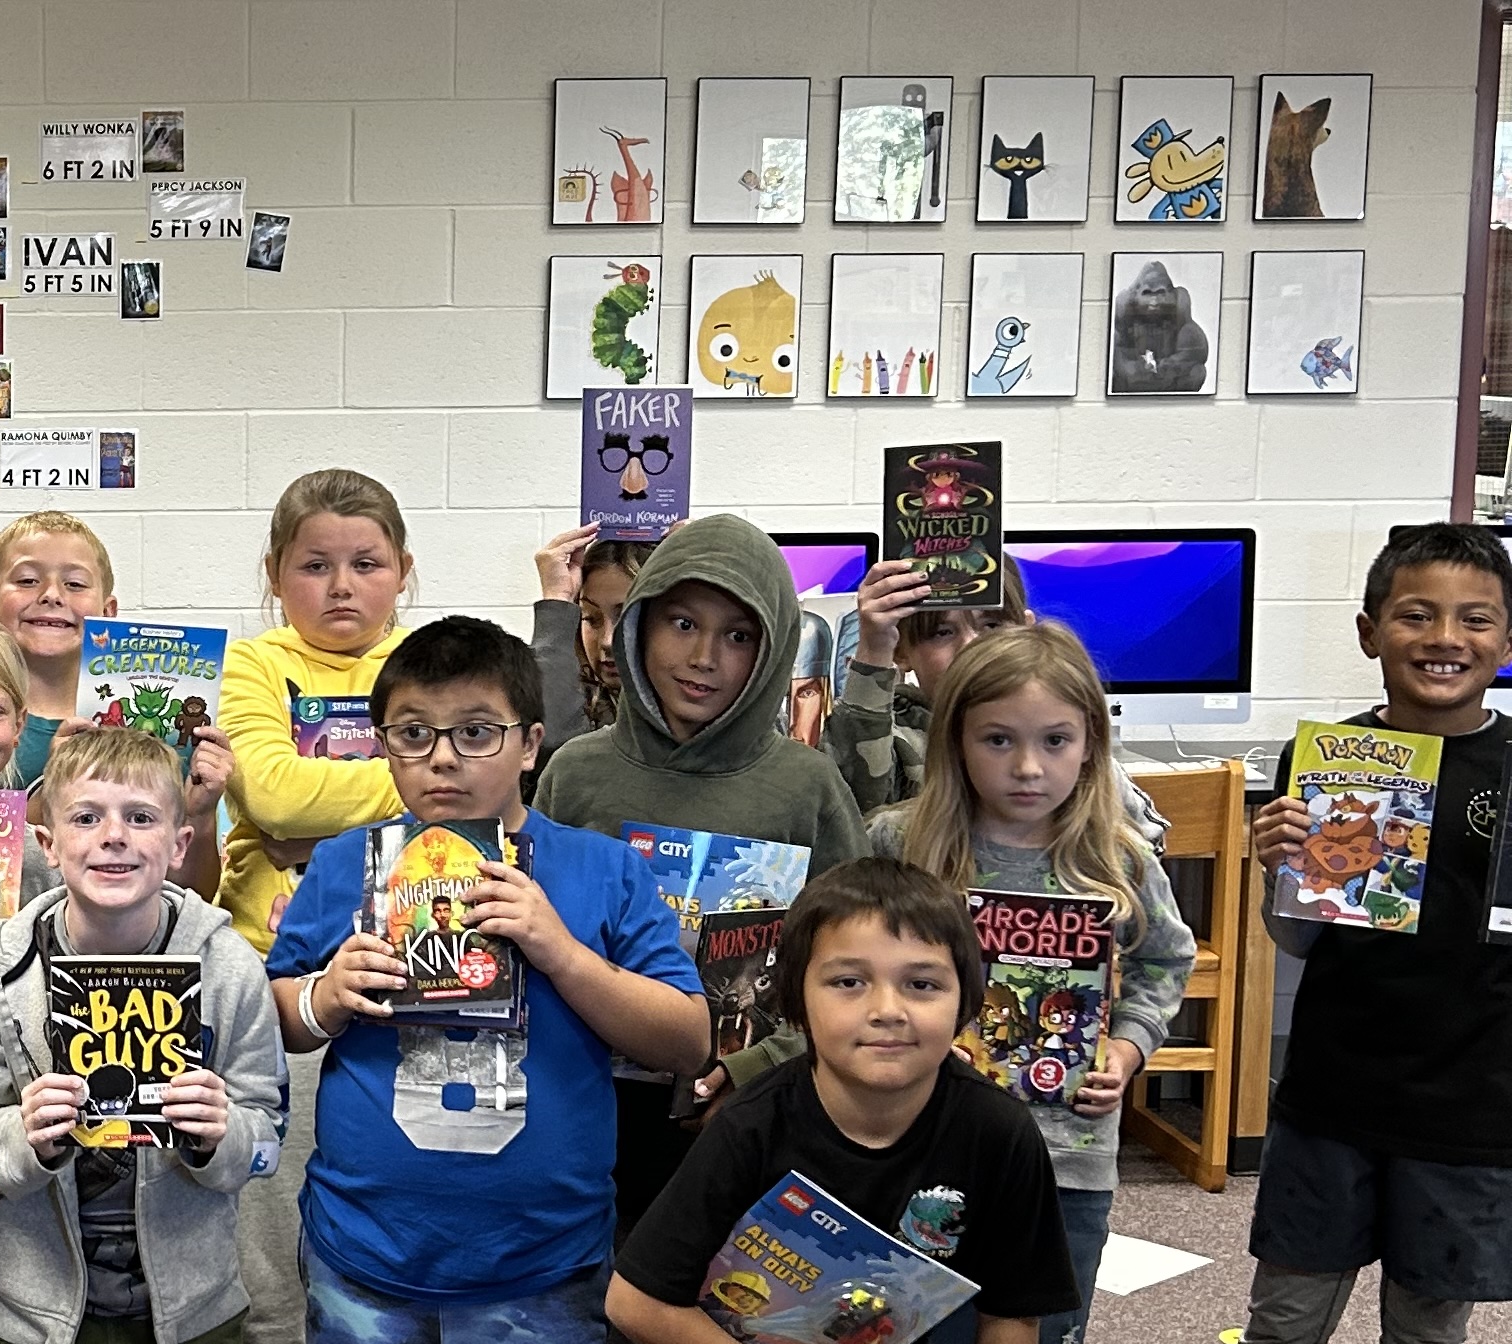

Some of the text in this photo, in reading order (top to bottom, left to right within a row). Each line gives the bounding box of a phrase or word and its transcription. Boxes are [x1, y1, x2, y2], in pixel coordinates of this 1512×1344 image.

[42, 122, 135, 135] WILLY WONKA
[42, 159, 134, 180] 6 FT 2 IN
[151, 181, 242, 192] PERCY JACKSON
[150, 219, 242, 238] 5 FT 9 IN
[23, 237, 112, 266] IVAN
[23, 274, 112, 293] 5 FT 5 IN
[594, 391, 681, 431] FAKER
[1, 431, 93, 441] RAMONA QUIMBY
[2, 468, 89, 486] 4 FT 2 IN
[589, 509, 679, 525] GORDON KORMAN
[896, 514, 990, 540] WICKED
[913, 535, 973, 555] WITCHES
[111, 637, 202, 657] LEGENDARY
[88, 653, 218, 681] CREATURES
[308, 701, 319, 717] 2
[331, 702, 352, 712] STEP
[1297, 771, 1347, 784] WRATH
[1367, 773, 1430, 792] LEGENDS
[630, 839, 692, 858] LEGO CITY
[973, 906, 1112, 936] ARCADE
[976, 927, 1100, 958] WORLD
[87, 977, 167, 988] AARON BLABEY
[70, 1002, 90, 1017] the
[89, 988, 183, 1033] BAD
[69, 1027, 187, 1077] GUYS
[784, 1191, 848, 1236] LEGO CITY
[745, 1224, 824, 1281] ALWAYS
[733, 1235, 816, 1293] ON DUTY
